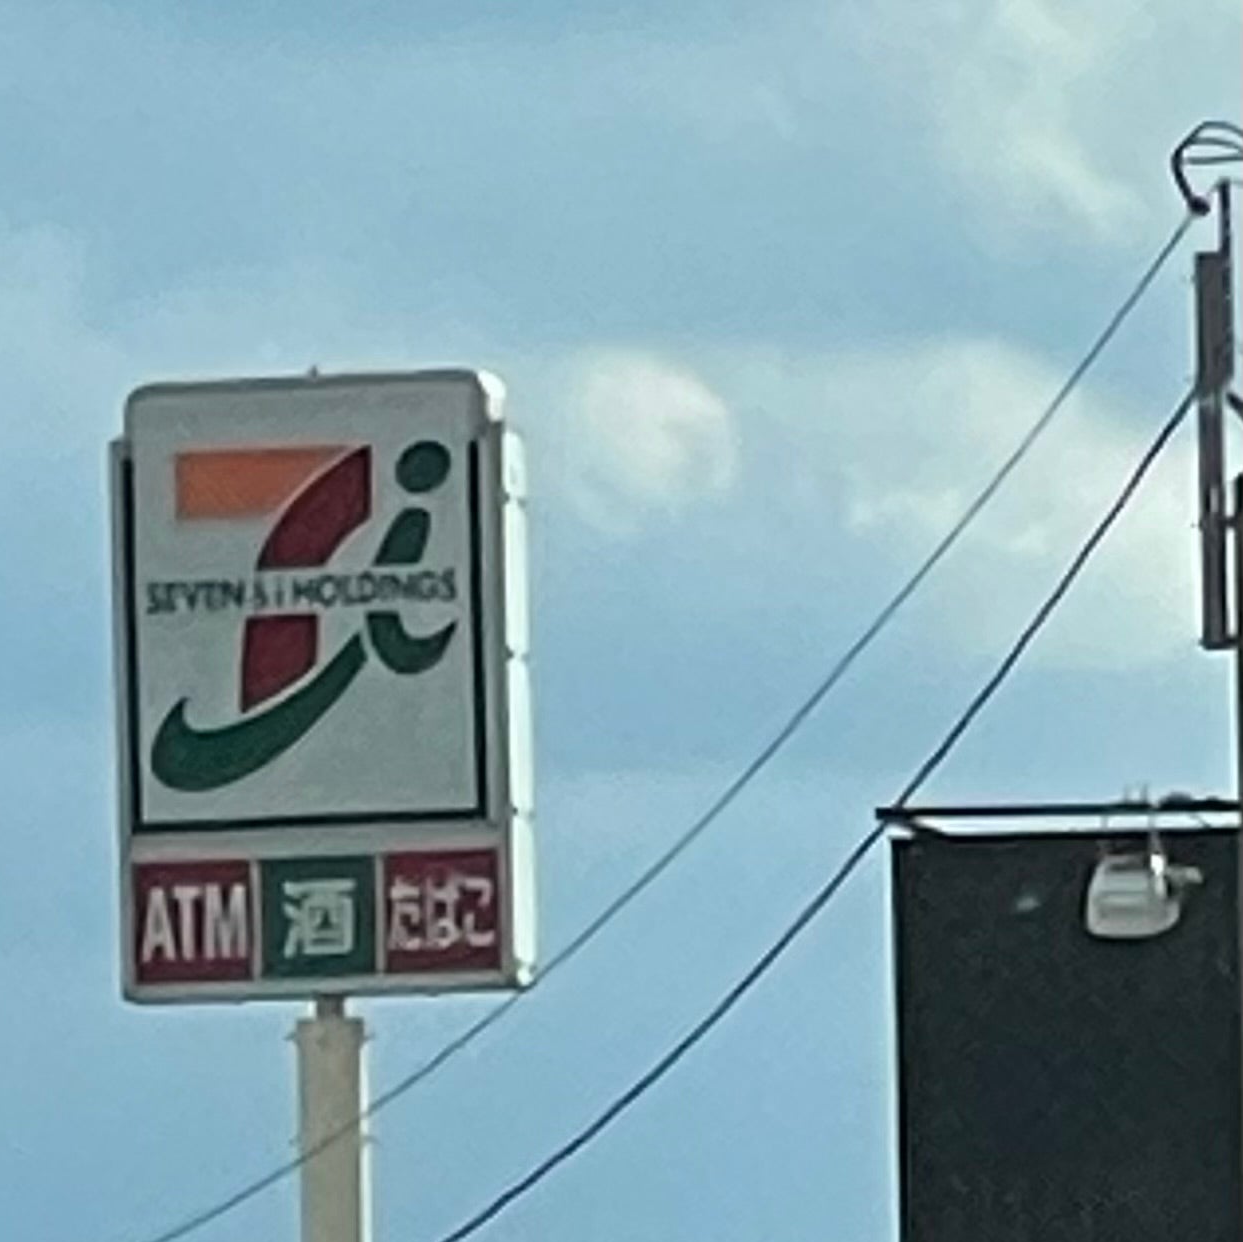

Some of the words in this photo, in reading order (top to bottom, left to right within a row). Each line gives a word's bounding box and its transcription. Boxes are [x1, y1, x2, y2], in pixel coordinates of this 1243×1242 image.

[146, 578, 245, 615] SEVEN
[292, 567, 456, 607] HOLDINGS
[141, 882, 248, 963] ATM
[282, 878, 356, 958] 酒
[390, 874, 496, 951] たばこ
